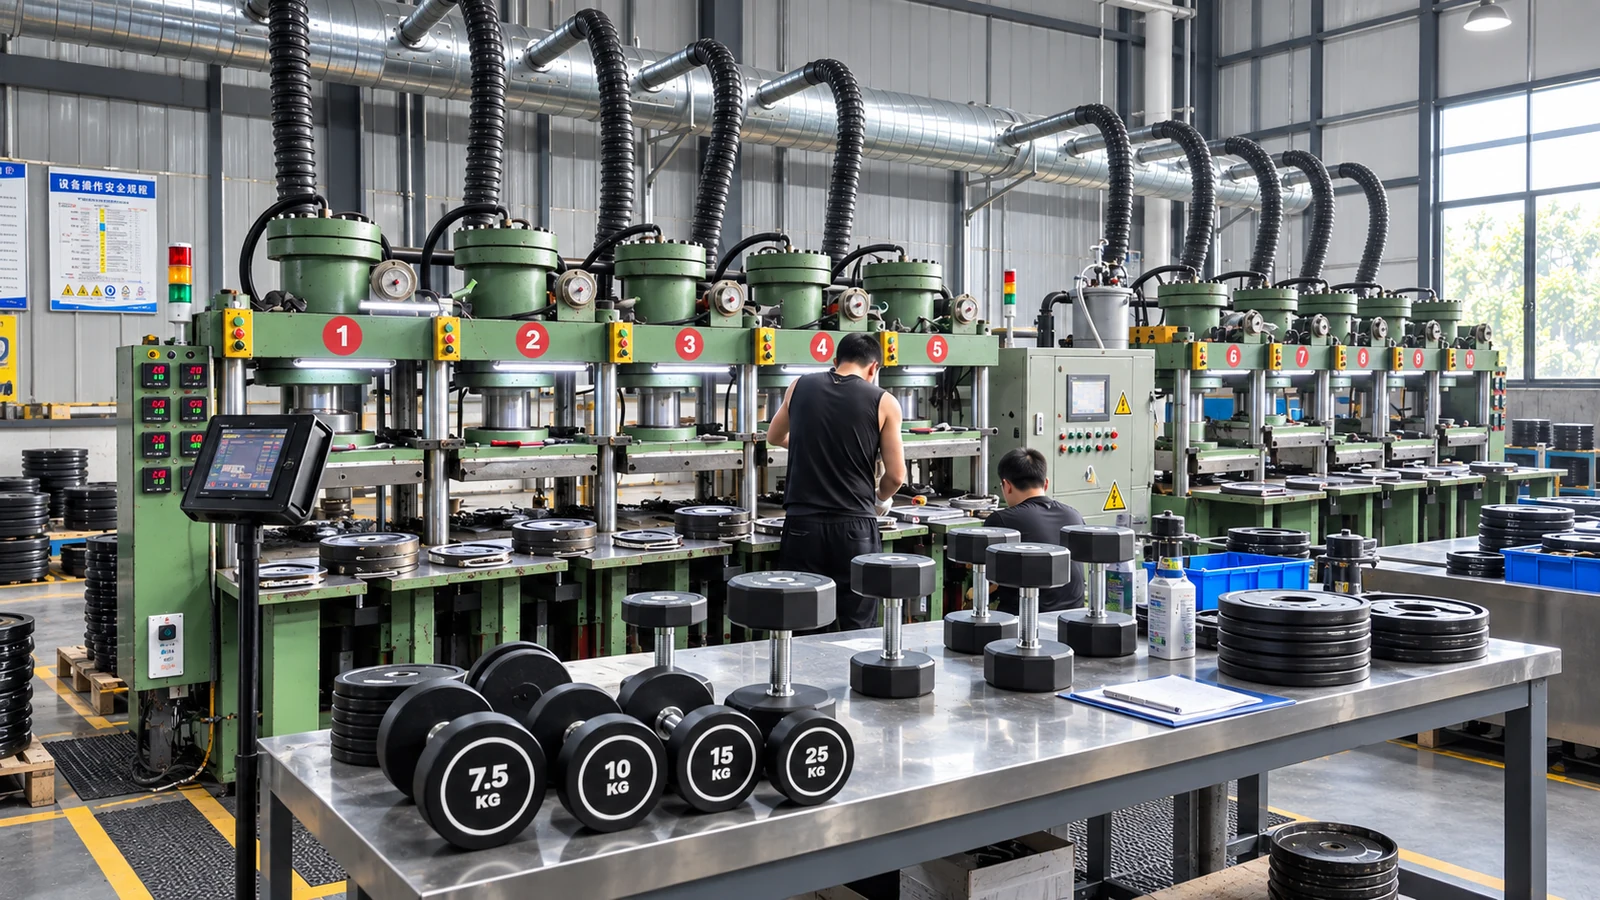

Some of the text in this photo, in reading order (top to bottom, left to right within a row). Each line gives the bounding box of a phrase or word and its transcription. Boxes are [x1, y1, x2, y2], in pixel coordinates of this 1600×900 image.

[336, 325, 348, 346] 1
[525, 329, 541, 350] 2
[683, 335, 697, 353] 3
[816, 338, 829, 356] 4
[932, 341, 943, 357] 5
[1230, 350, 1237, 363] 6
[1299, 350, 1306, 363] 7
[1360, 351, 1367, 364] 8
[1415, 352, 1422, 365] 9
[710, 745, 734, 766] 15
[805, 745, 829, 765] 25
[468, 763, 509, 793] 7.5
[604, 759, 631, 780] 10
[711, 767, 731, 781] KG
[807, 766, 826, 779] KG
[606, 780, 630, 796] KG
[475, 791, 501, 810] KG
